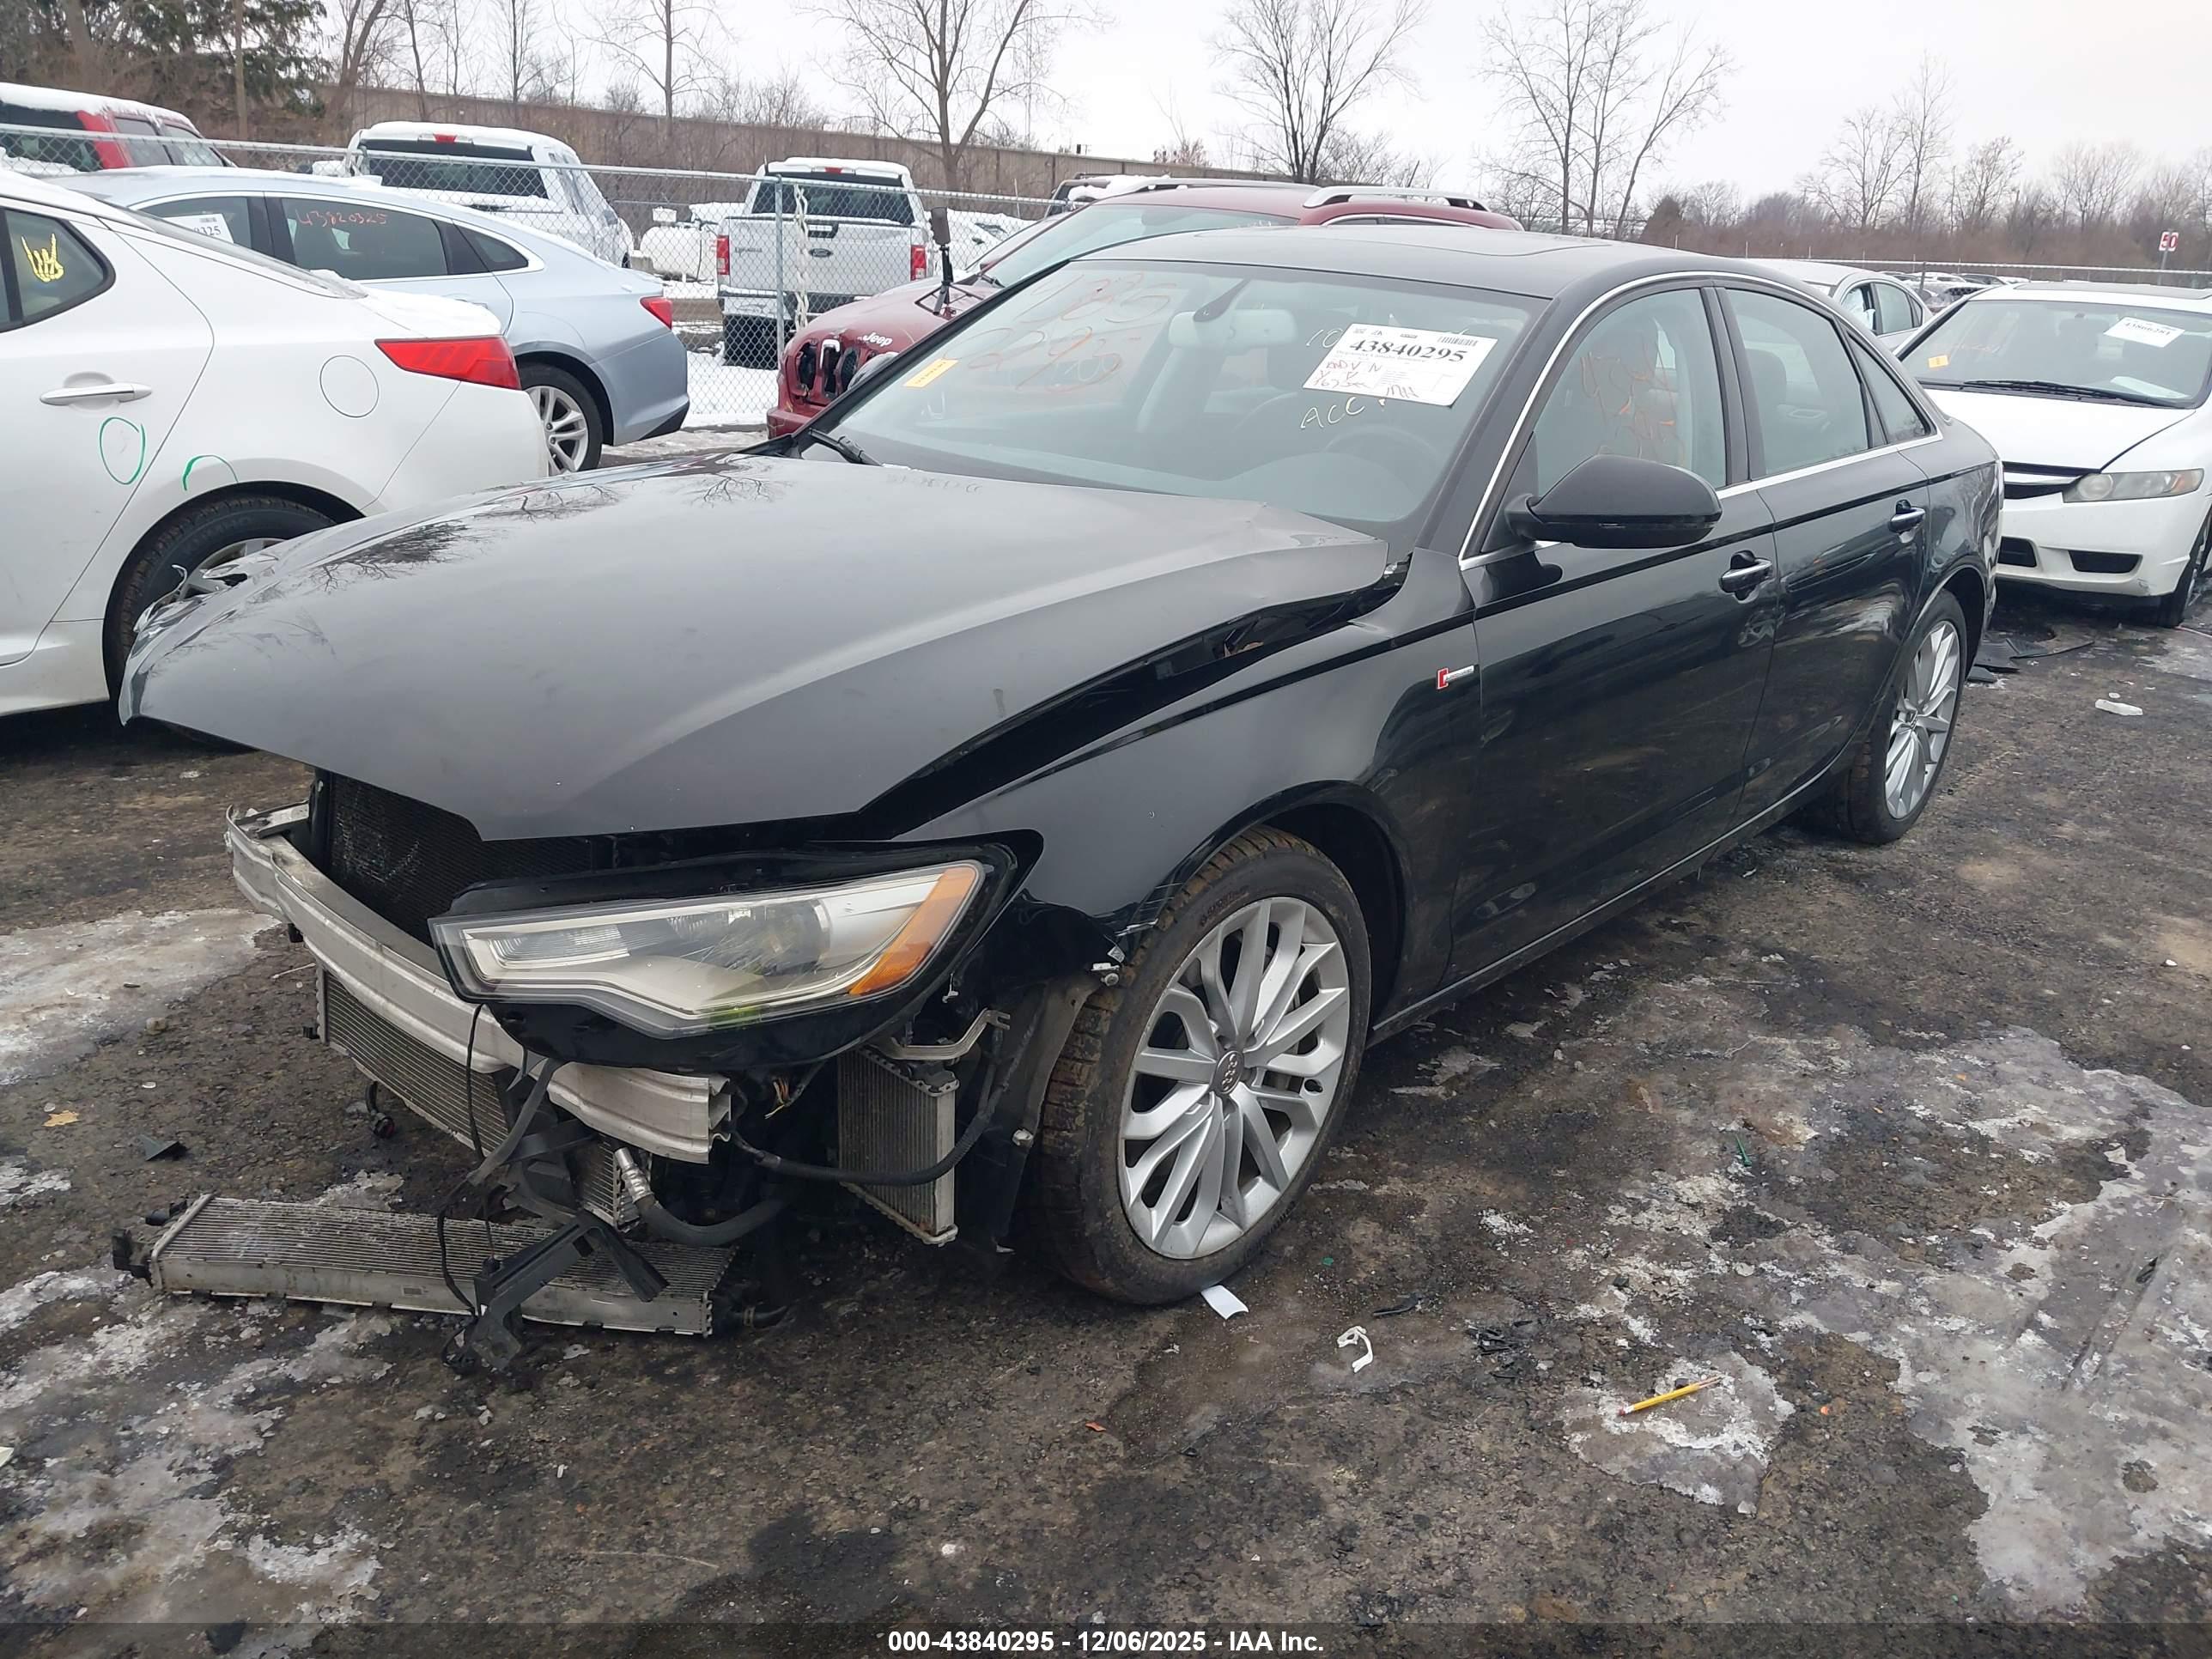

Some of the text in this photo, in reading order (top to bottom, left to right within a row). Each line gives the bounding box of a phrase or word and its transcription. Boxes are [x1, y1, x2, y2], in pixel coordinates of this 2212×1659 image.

[295, 209, 388, 227] 43820325
[2161, 234, 2179, 248] 50
[862, 332, 893, 347] Jeep
[1349, 339, 1468, 362] 43840295
